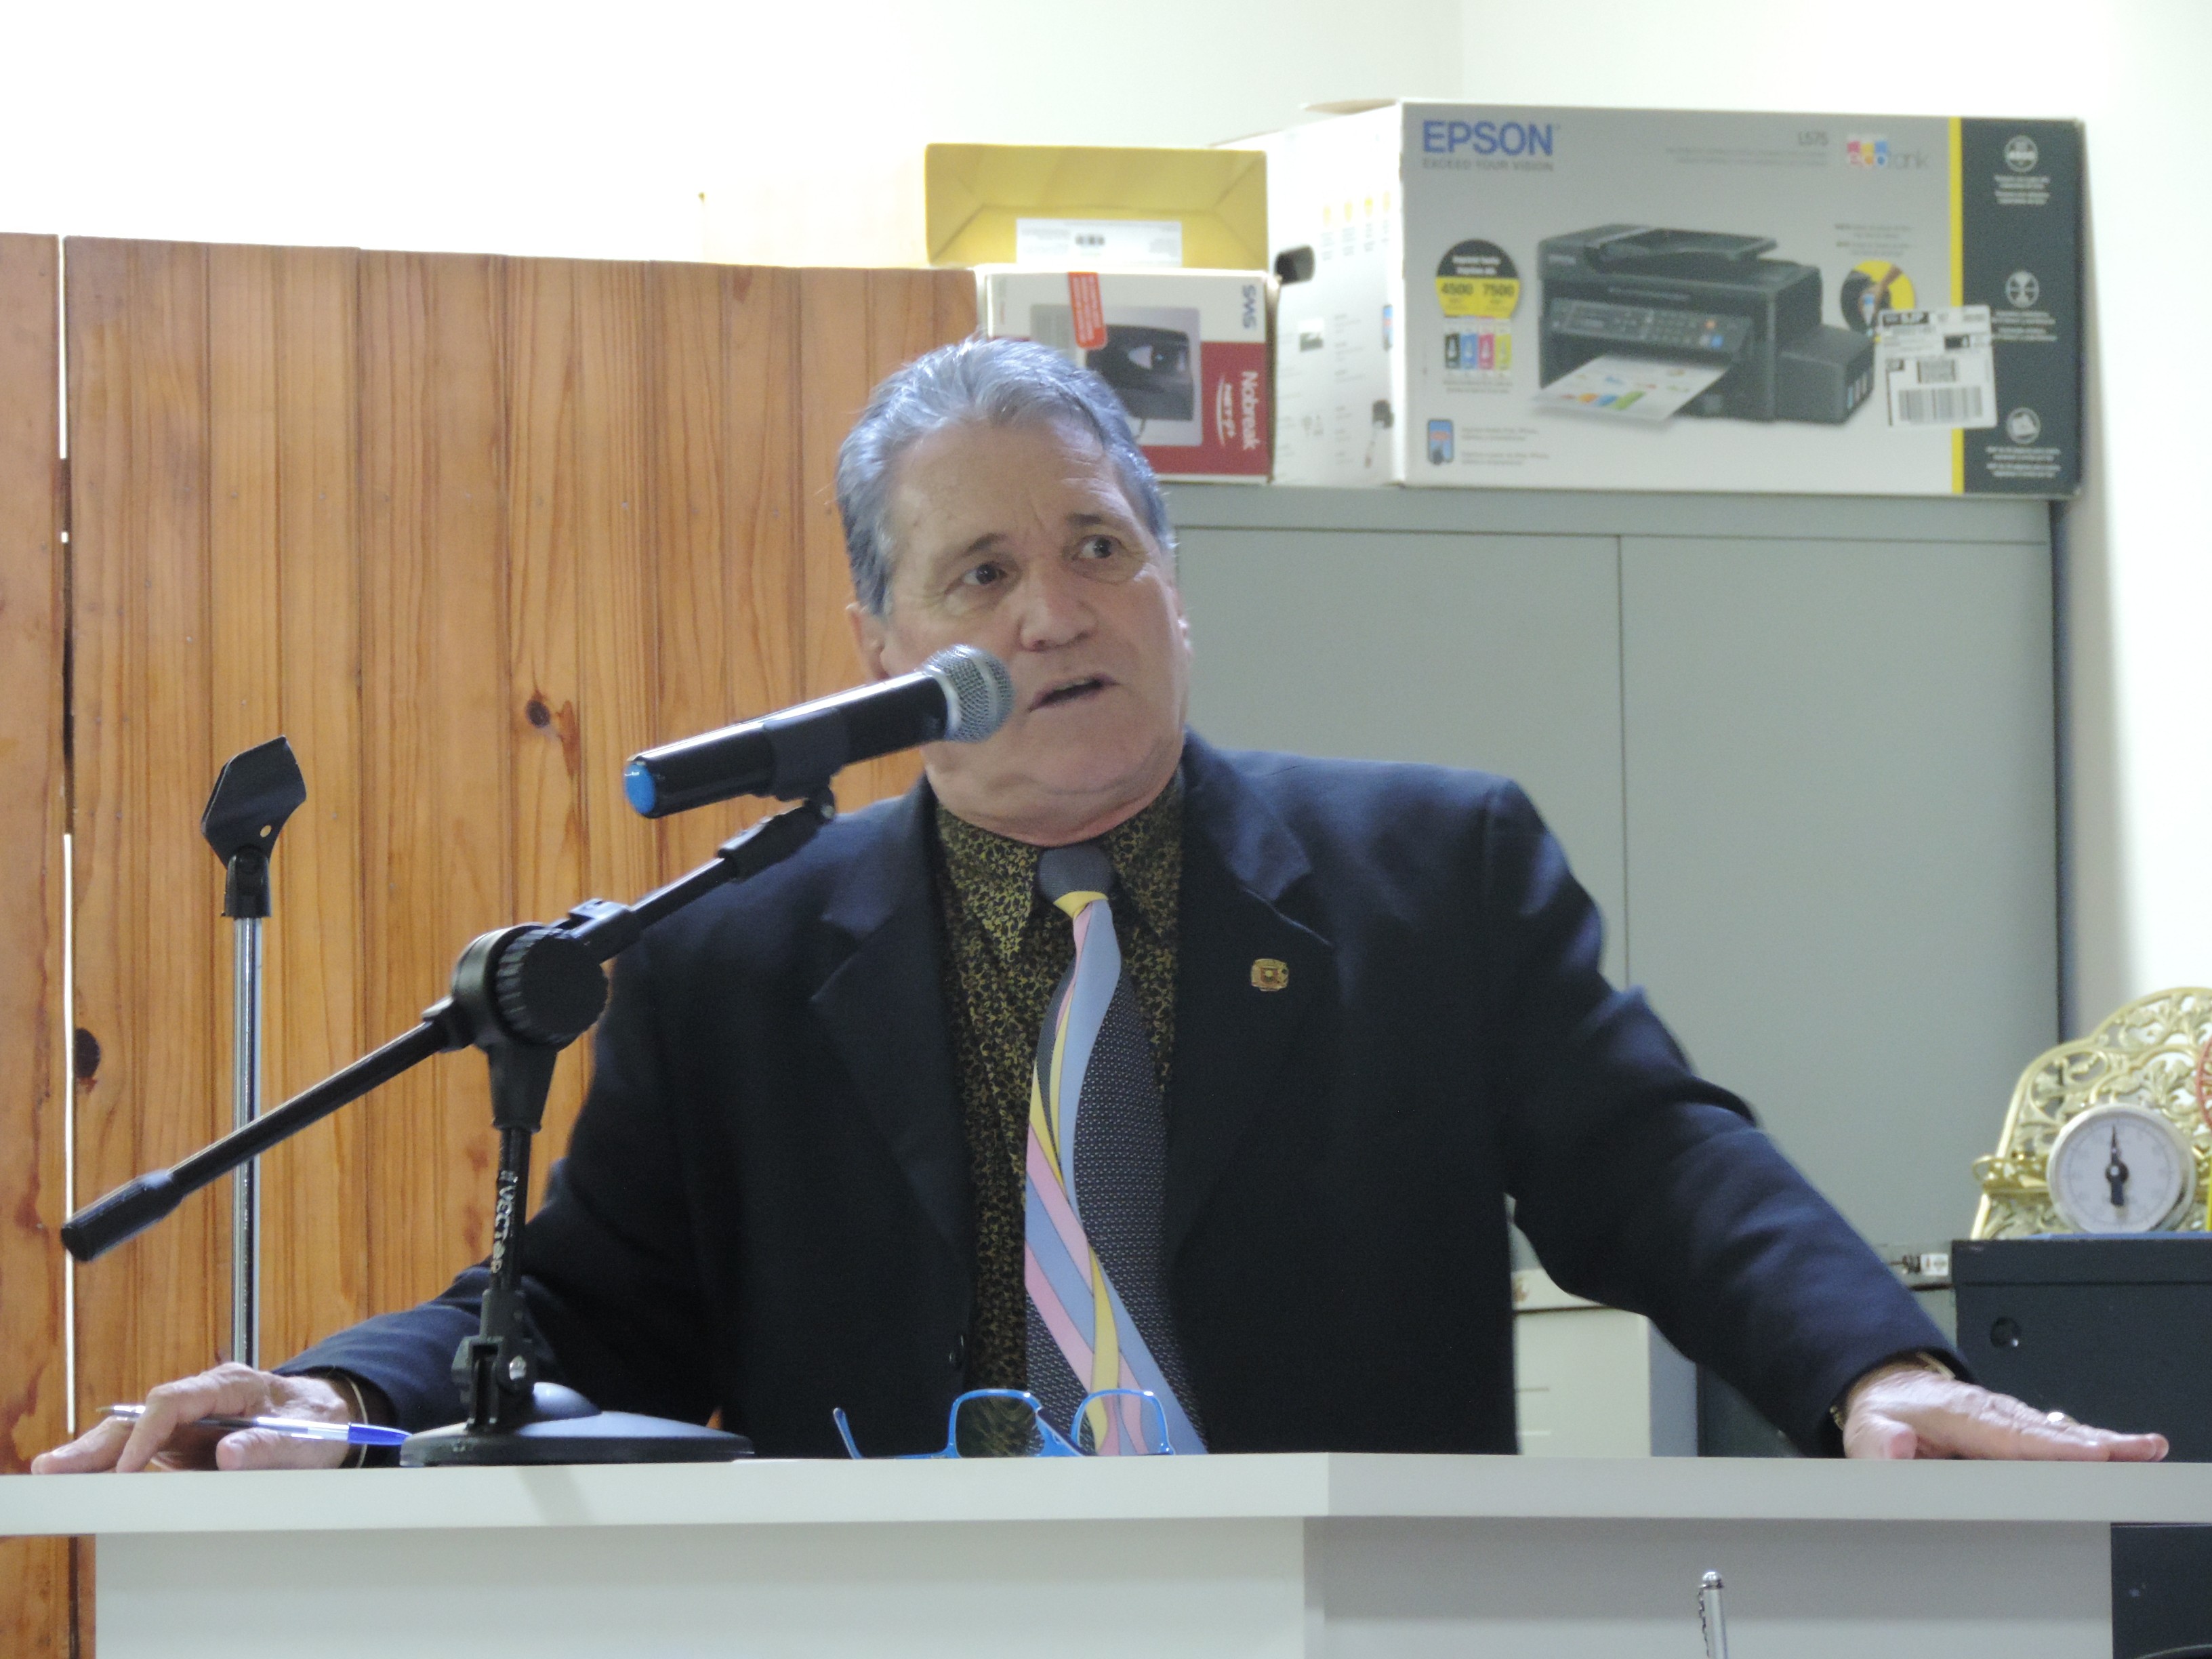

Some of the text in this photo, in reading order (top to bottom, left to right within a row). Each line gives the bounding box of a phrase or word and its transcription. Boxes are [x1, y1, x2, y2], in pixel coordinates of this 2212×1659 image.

[1422, 120, 1553, 157] EPSON
[1242, 284, 1257, 329] SMS
[1241, 371, 1260, 451] Nobreak
